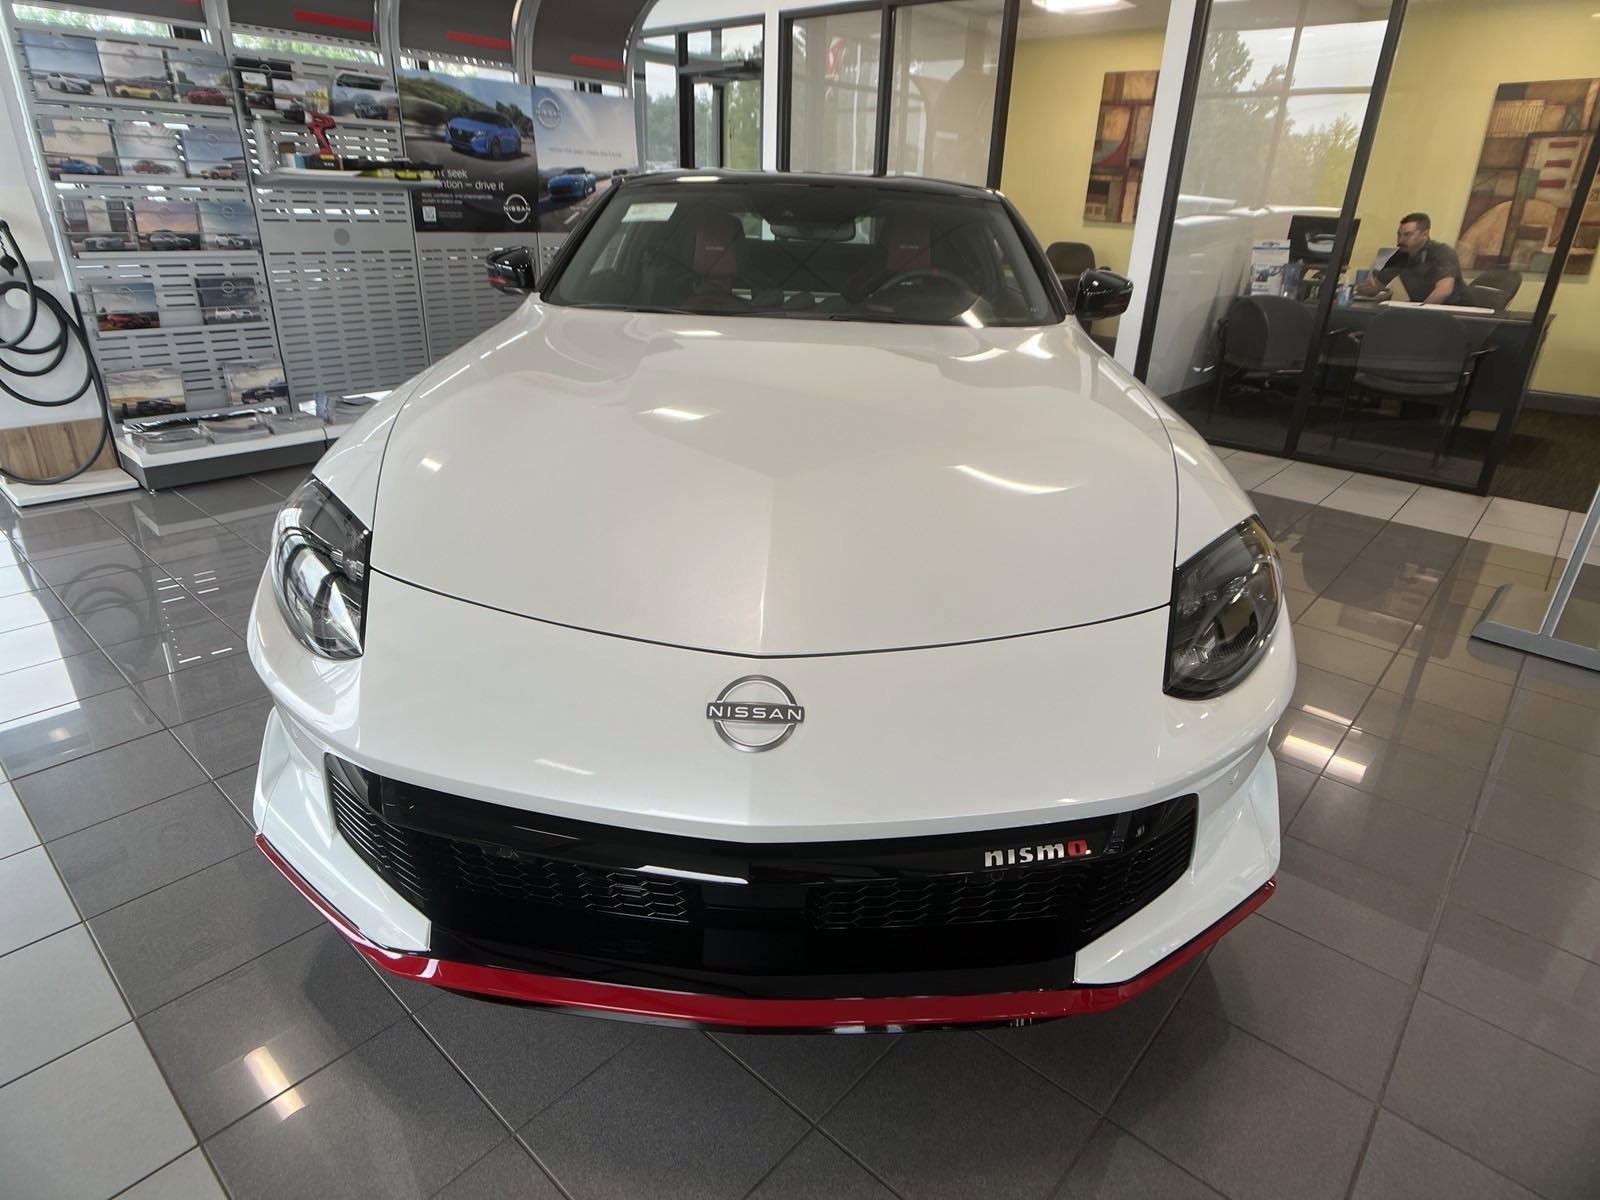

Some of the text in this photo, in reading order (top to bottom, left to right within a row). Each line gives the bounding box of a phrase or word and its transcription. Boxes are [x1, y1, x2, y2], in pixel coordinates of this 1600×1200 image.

[447, 168, 468, 178] seek
[440, 180, 463, 190] ntion
[475, 181, 496, 191] drive
[498, 181, 505, 191] it
[503, 205, 531, 213] NISSAN
[708, 705, 802, 720] NISSAN
